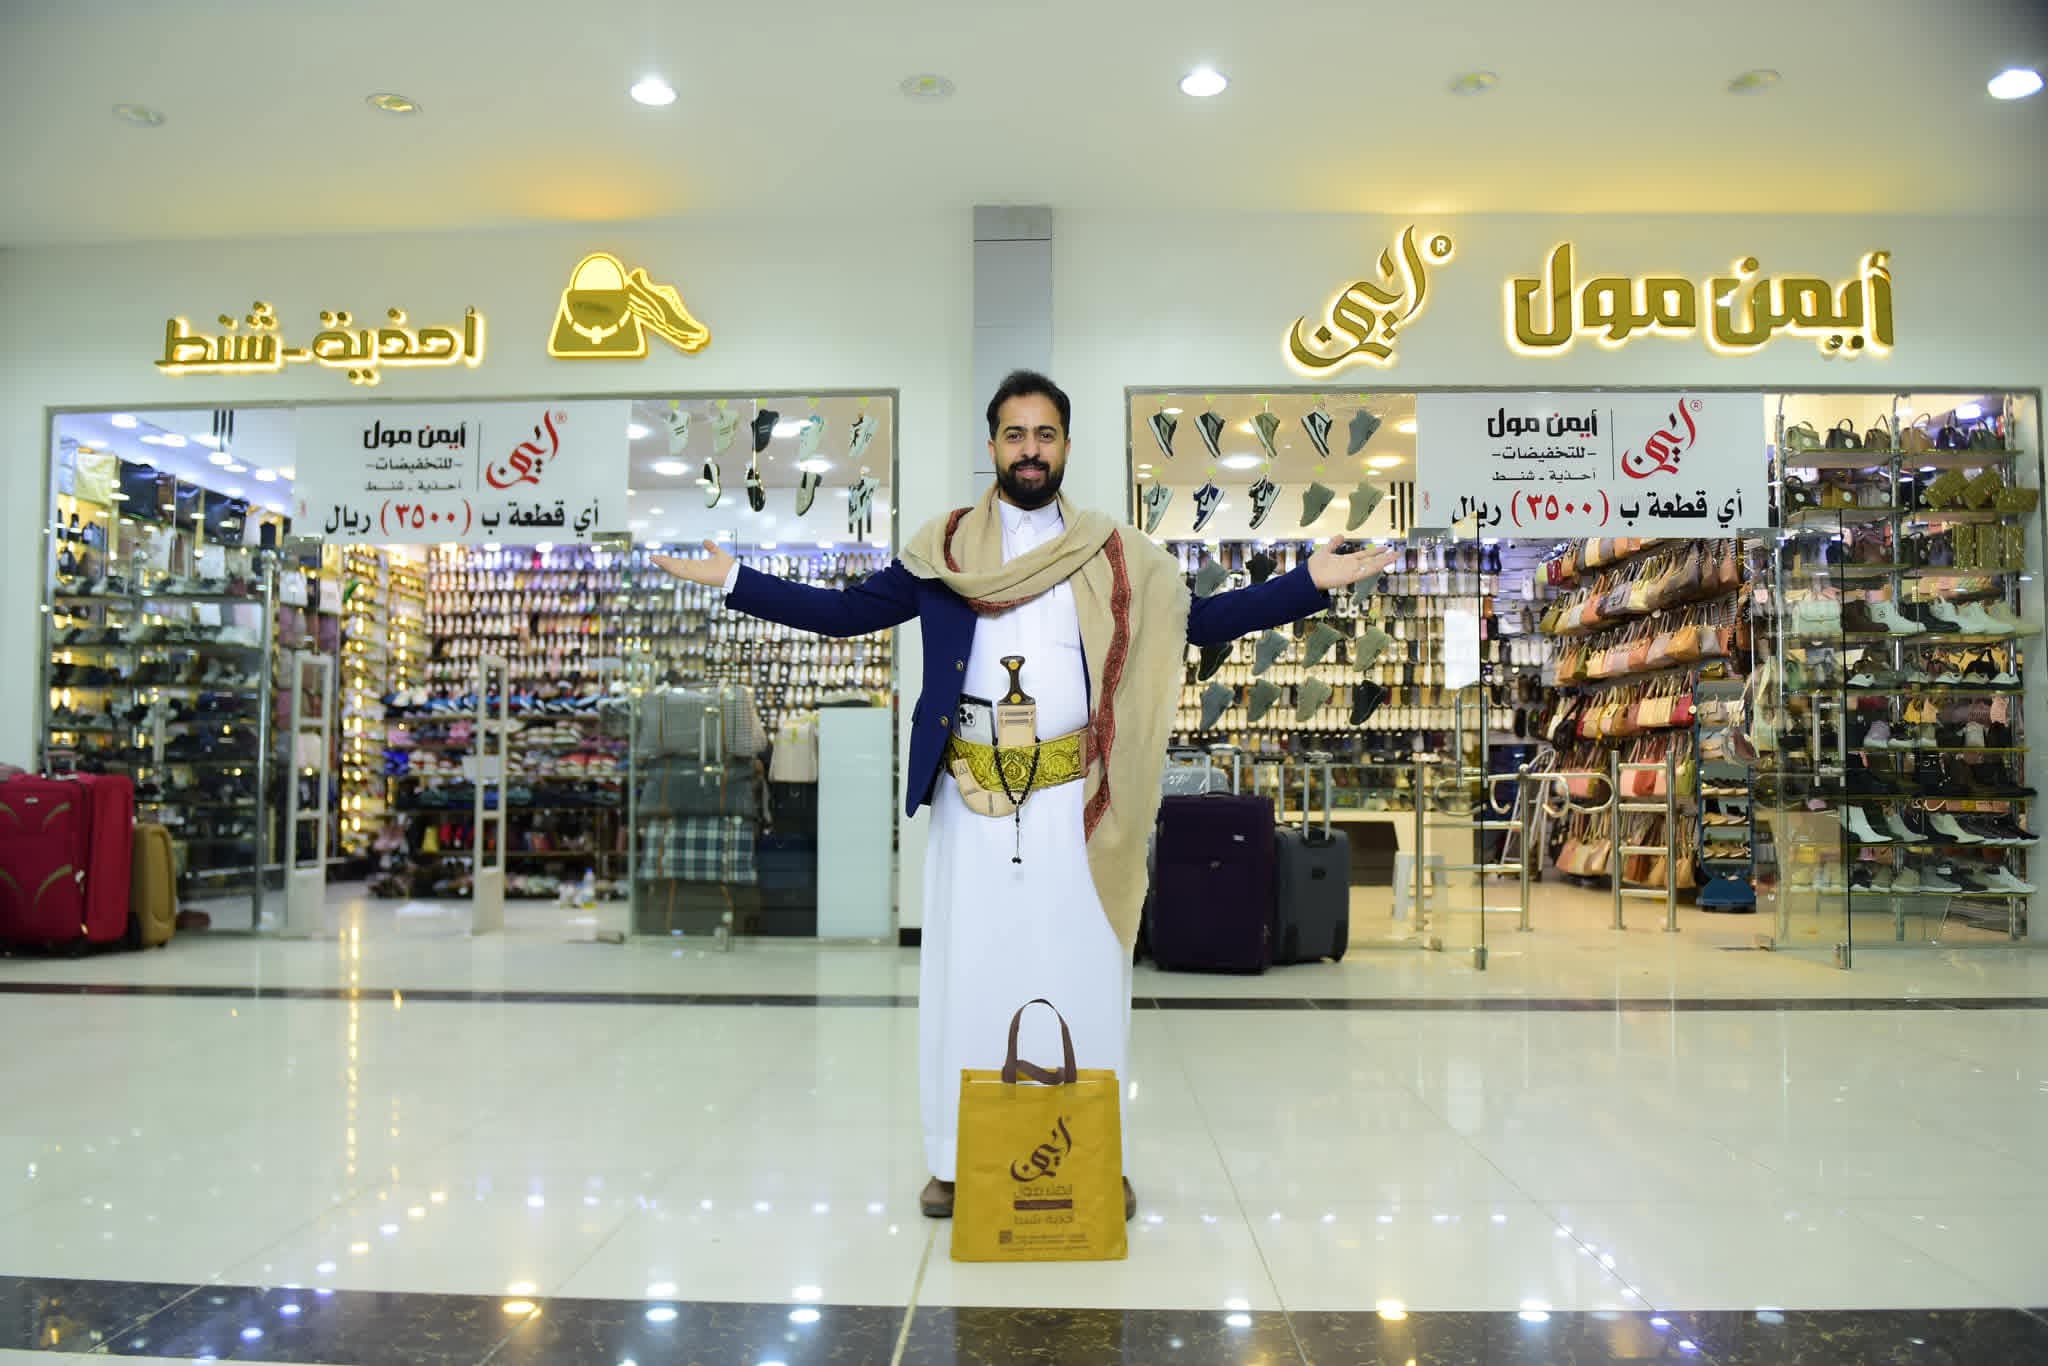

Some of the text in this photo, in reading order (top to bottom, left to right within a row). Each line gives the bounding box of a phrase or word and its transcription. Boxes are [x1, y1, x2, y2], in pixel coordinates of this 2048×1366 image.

[1514, 243, 1894, 350] أيمن مول
[363, 419, 467, 449] أيمن مول
[1487, 407, 1598, 438] أيمن مول
[325, 504, 371, 536] ريال
[508, 500, 565, 528] قطعة
[573, 498, 599, 537] أي
[1619, 500, 1640, 527] ب
[1647, 489, 1708, 520] قطعة
[1715, 488, 1743, 529] أي
[481, 509, 500, 535] ب
